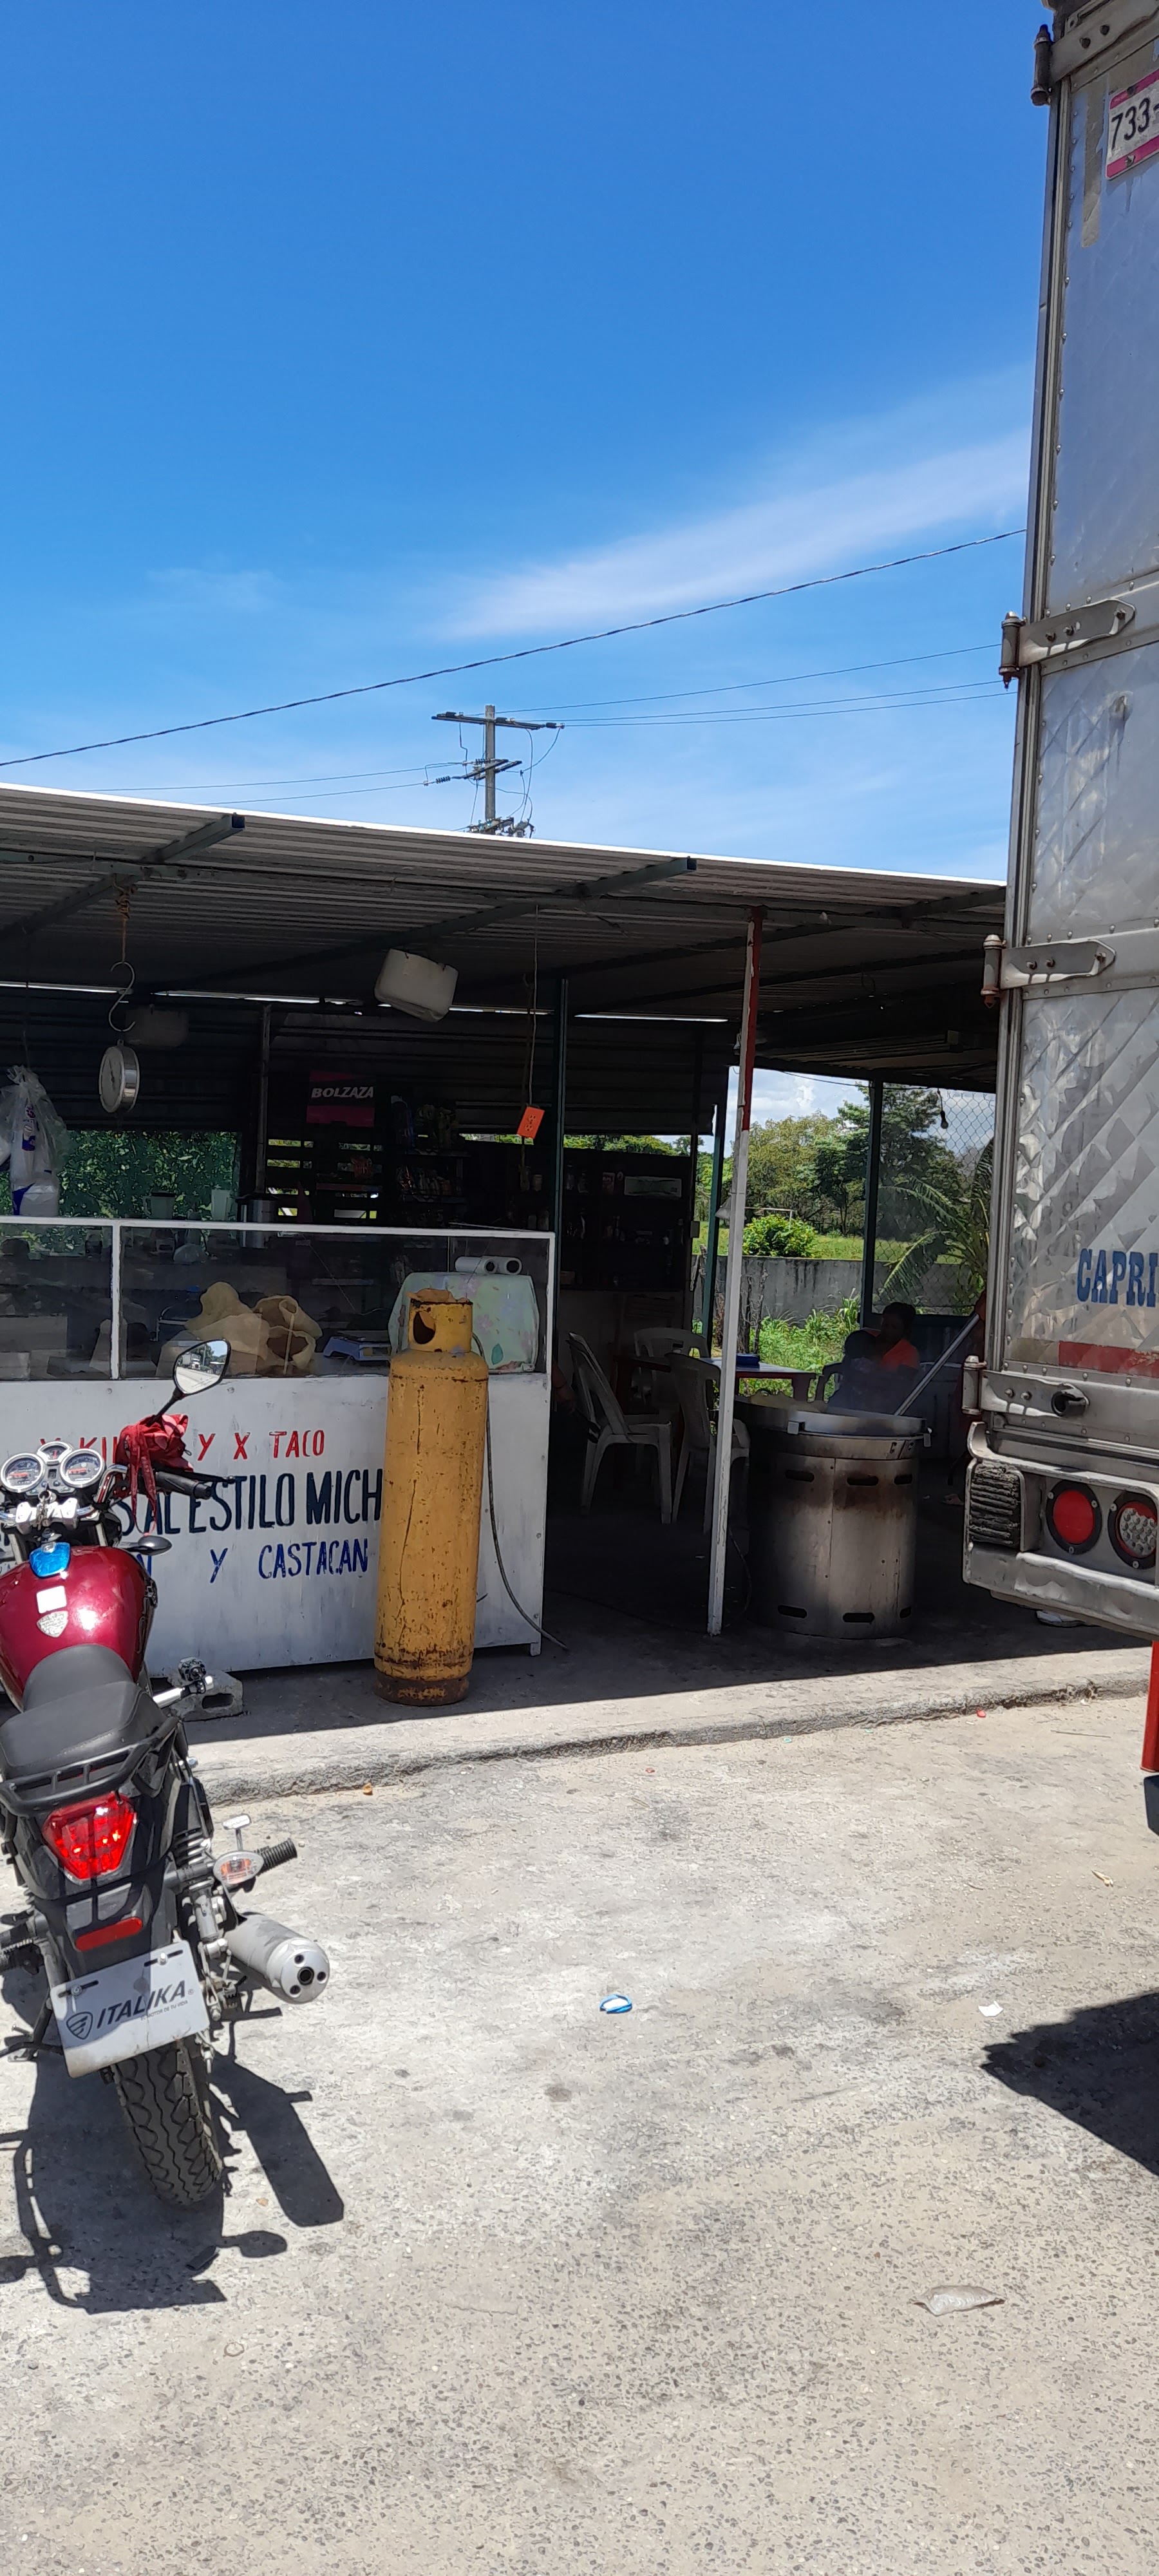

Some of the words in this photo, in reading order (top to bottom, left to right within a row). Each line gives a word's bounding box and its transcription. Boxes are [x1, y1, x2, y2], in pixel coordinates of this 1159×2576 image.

[311, 1086, 373, 1099] BOLZAZA
[1077, 1248, 1158, 1307] CAPRI
[197, 1432, 216, 1461] Y
[233, 1432, 251, 1460] X
[269, 1430, 325, 1458] TACO
[189, 1473, 295, 1533] ESTILO
[210, 1548, 229, 1584] Y
[258, 1538, 368, 1579] CASTACAN
[97, 1980, 185, 2029] ITALIKA
